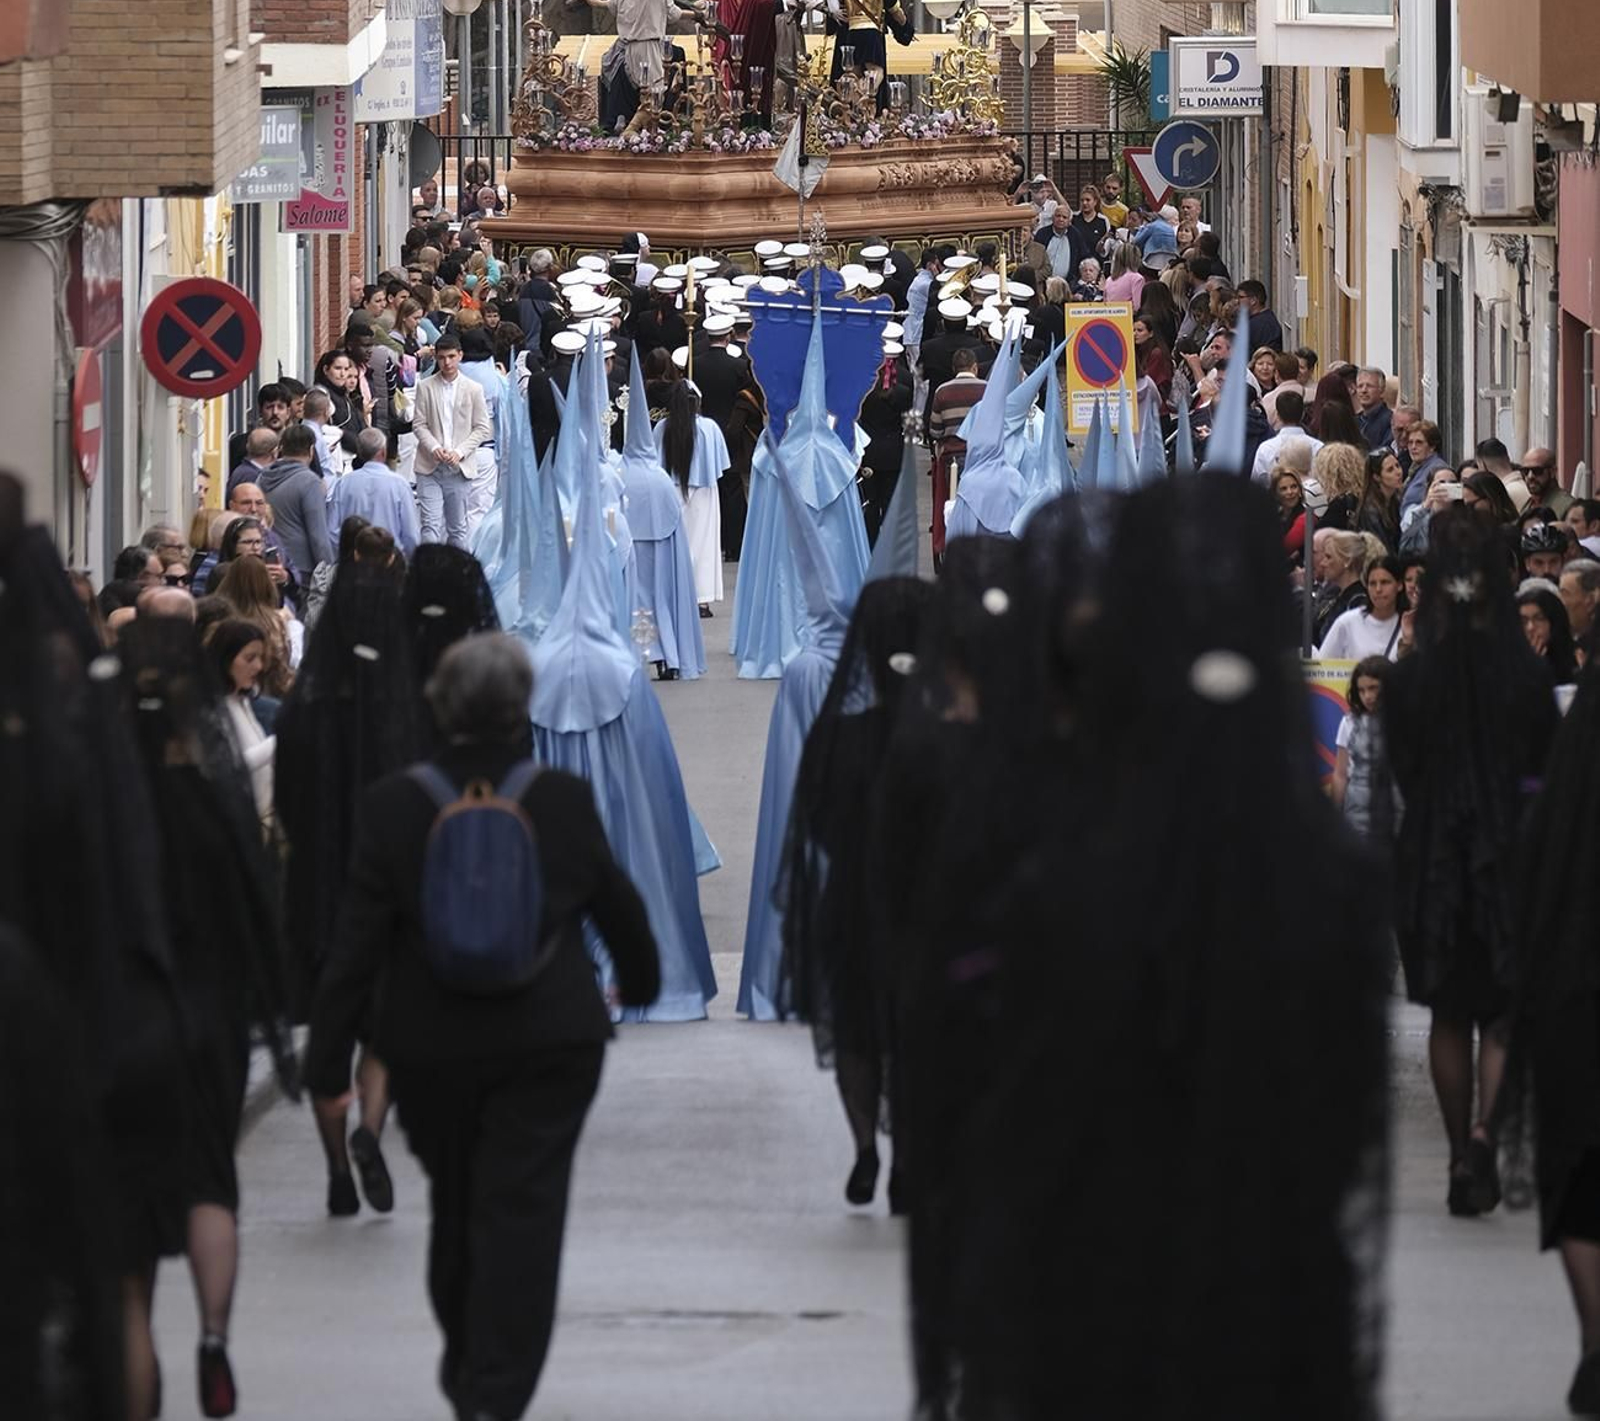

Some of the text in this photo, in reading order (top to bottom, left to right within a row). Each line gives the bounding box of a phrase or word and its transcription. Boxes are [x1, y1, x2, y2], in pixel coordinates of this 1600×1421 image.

[1179, 97, 1264, 107] EL DIAMANTE
[333, 86, 346, 197] ELUQUERIA
[247, 182, 295, 195] GRANITOS
[289, 202, 347, 226] Salomé
